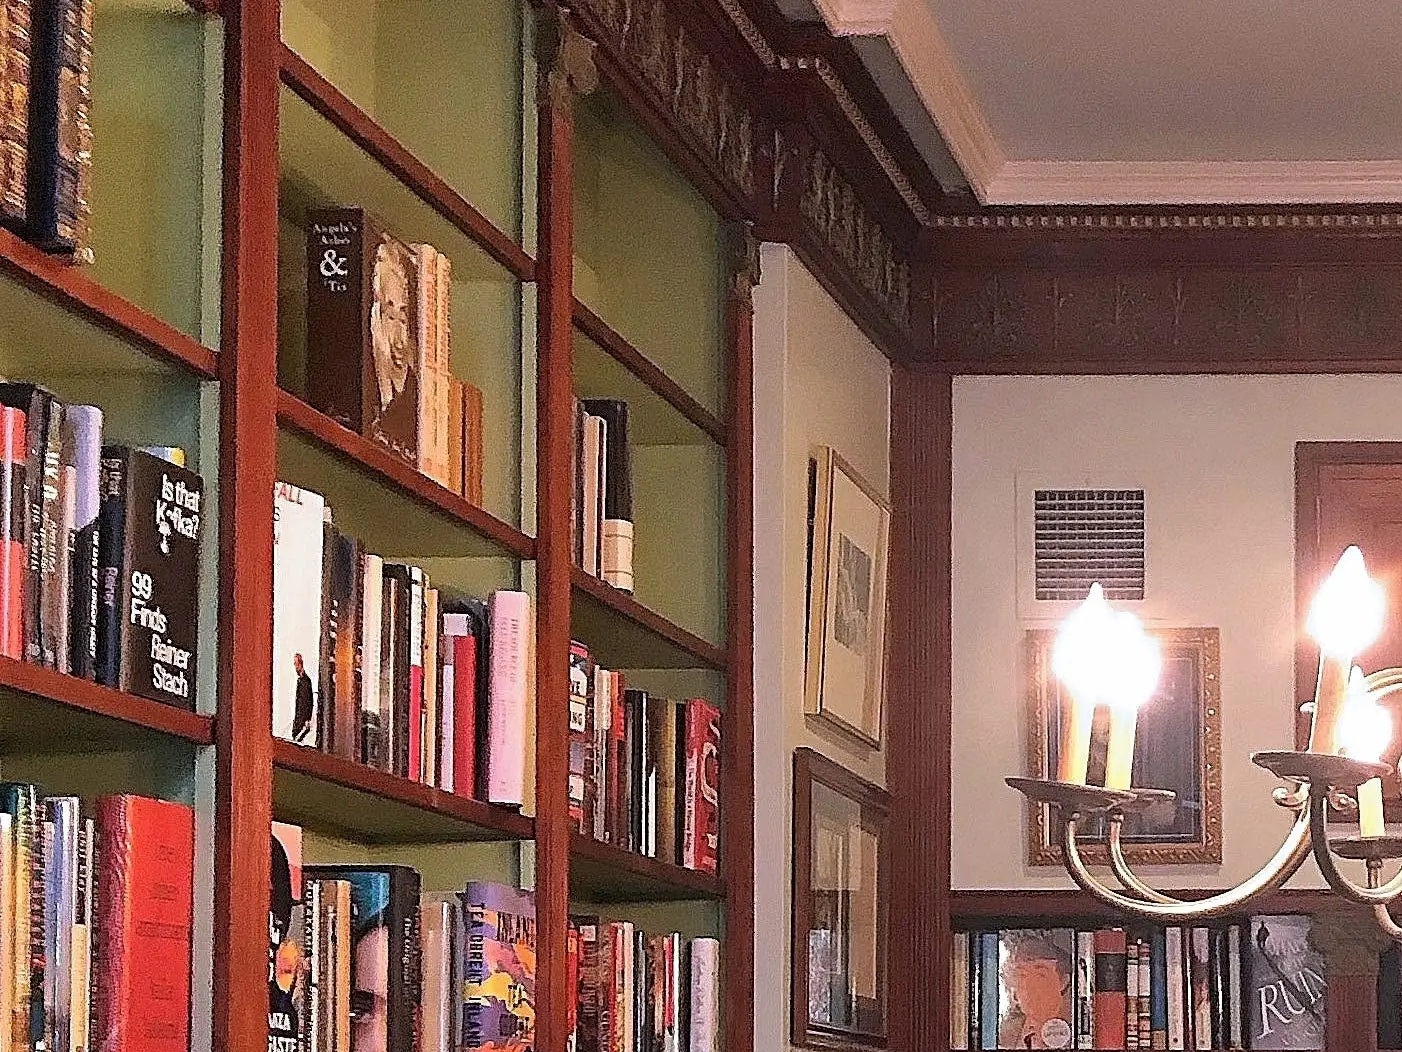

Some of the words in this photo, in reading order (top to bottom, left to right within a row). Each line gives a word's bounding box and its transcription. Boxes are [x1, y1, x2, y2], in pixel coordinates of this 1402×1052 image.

[320, 249, 348, 276] &
[162, 473, 174, 501] Is
[175, 480, 200, 512] that
[130, 597, 168, 635] Finds
[150, 633, 193, 670] Reiner
[152, 662, 188, 697] Stach
